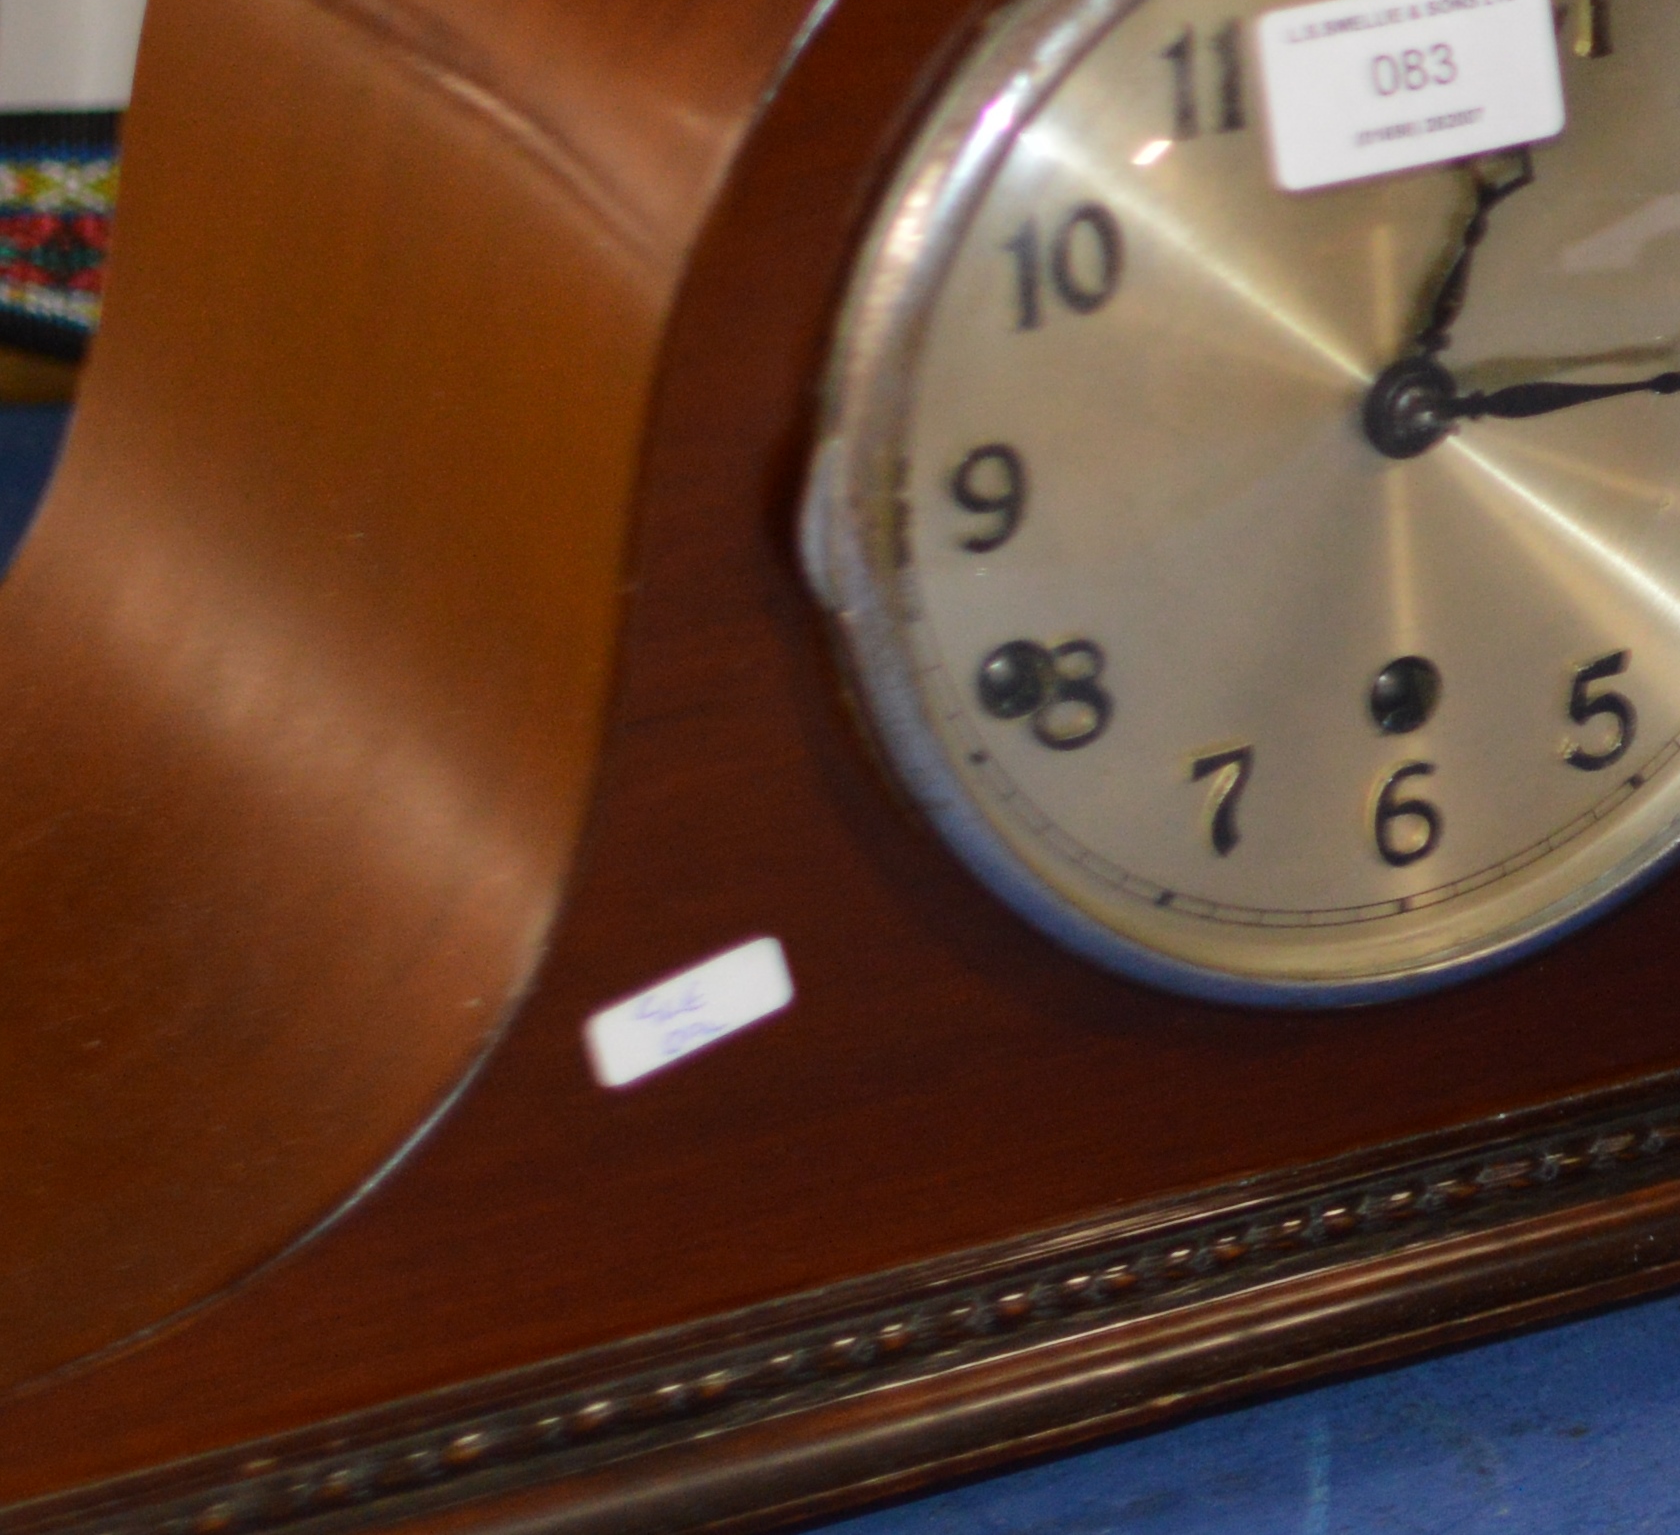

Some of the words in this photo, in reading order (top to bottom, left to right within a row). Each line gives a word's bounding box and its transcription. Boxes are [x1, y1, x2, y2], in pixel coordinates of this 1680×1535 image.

[1158, 14, 1247, 140] 11
[1370, 42, 1459, 97] 083
[1002, 202, 1124, 335] 10
[947, 441, 1030, 553] 9
[1026, 635, 1117, 752] 8
[1562, 649, 1639, 772] 5
[1186, 741, 1256, 859] 7
[1369, 758, 1444, 868] 6
